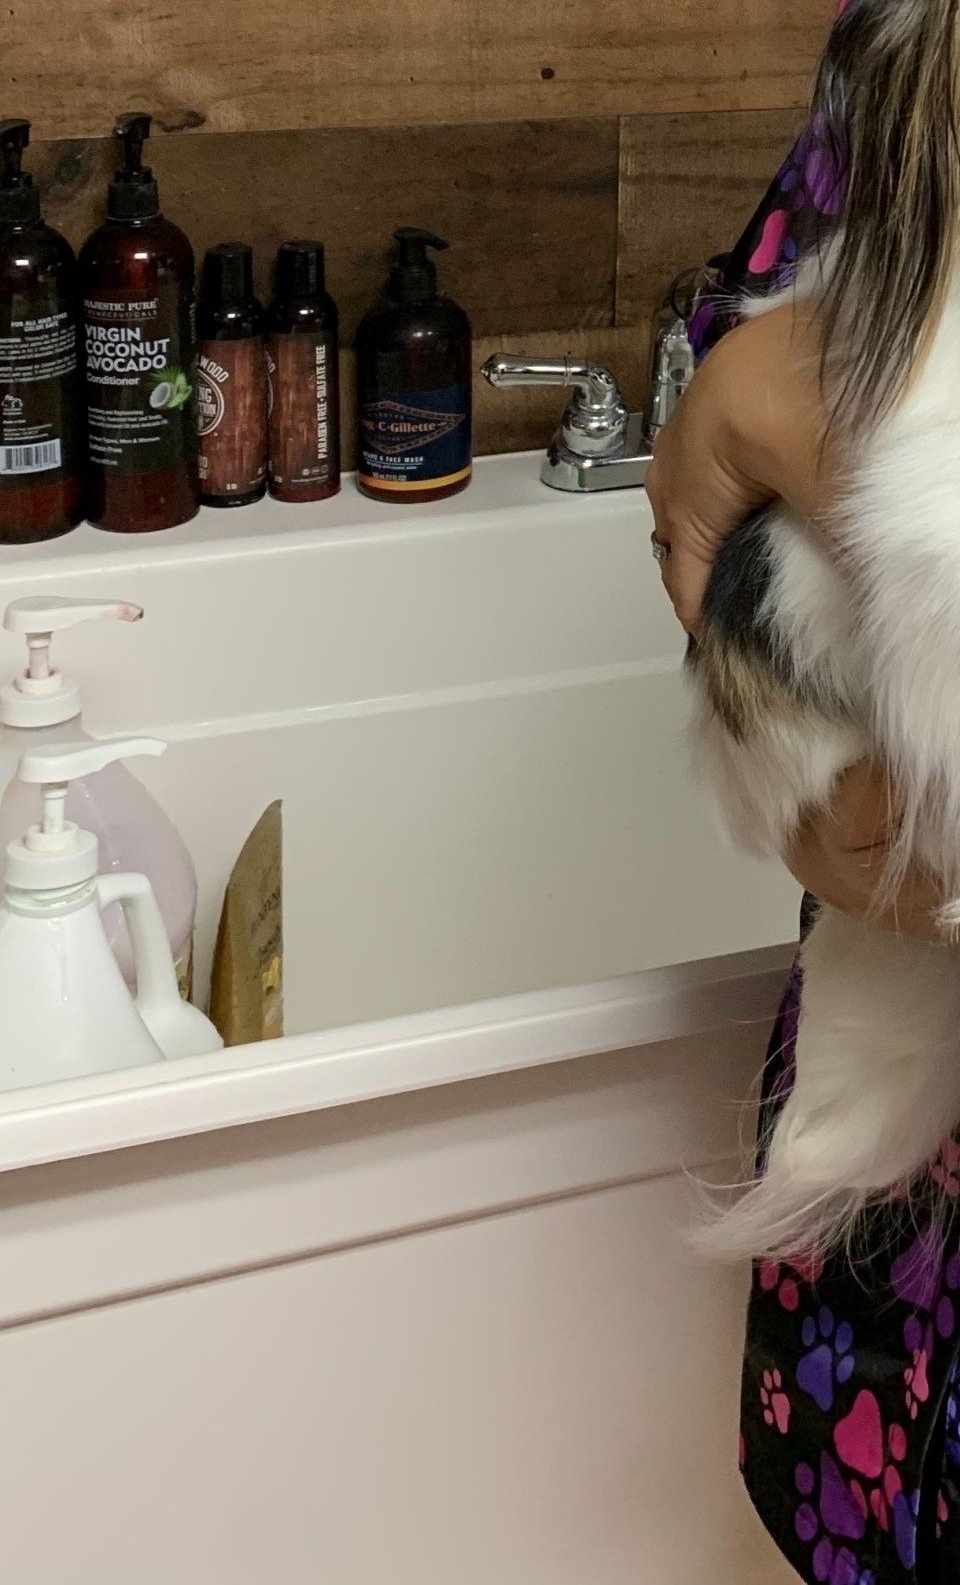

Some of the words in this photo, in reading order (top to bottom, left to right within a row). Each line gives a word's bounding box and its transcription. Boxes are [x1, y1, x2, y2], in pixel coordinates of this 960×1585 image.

[128, 300, 157, 312] PURE
[84, 323, 141, 342] VIRGIN
[85, 338, 170, 357] COCONUT
[315, 344, 326, 365] FREE
[86, 354, 167, 372] AVOCADO
[86, 372, 140, 386] Conditioner
[317, 401, 327, 421] FREE
